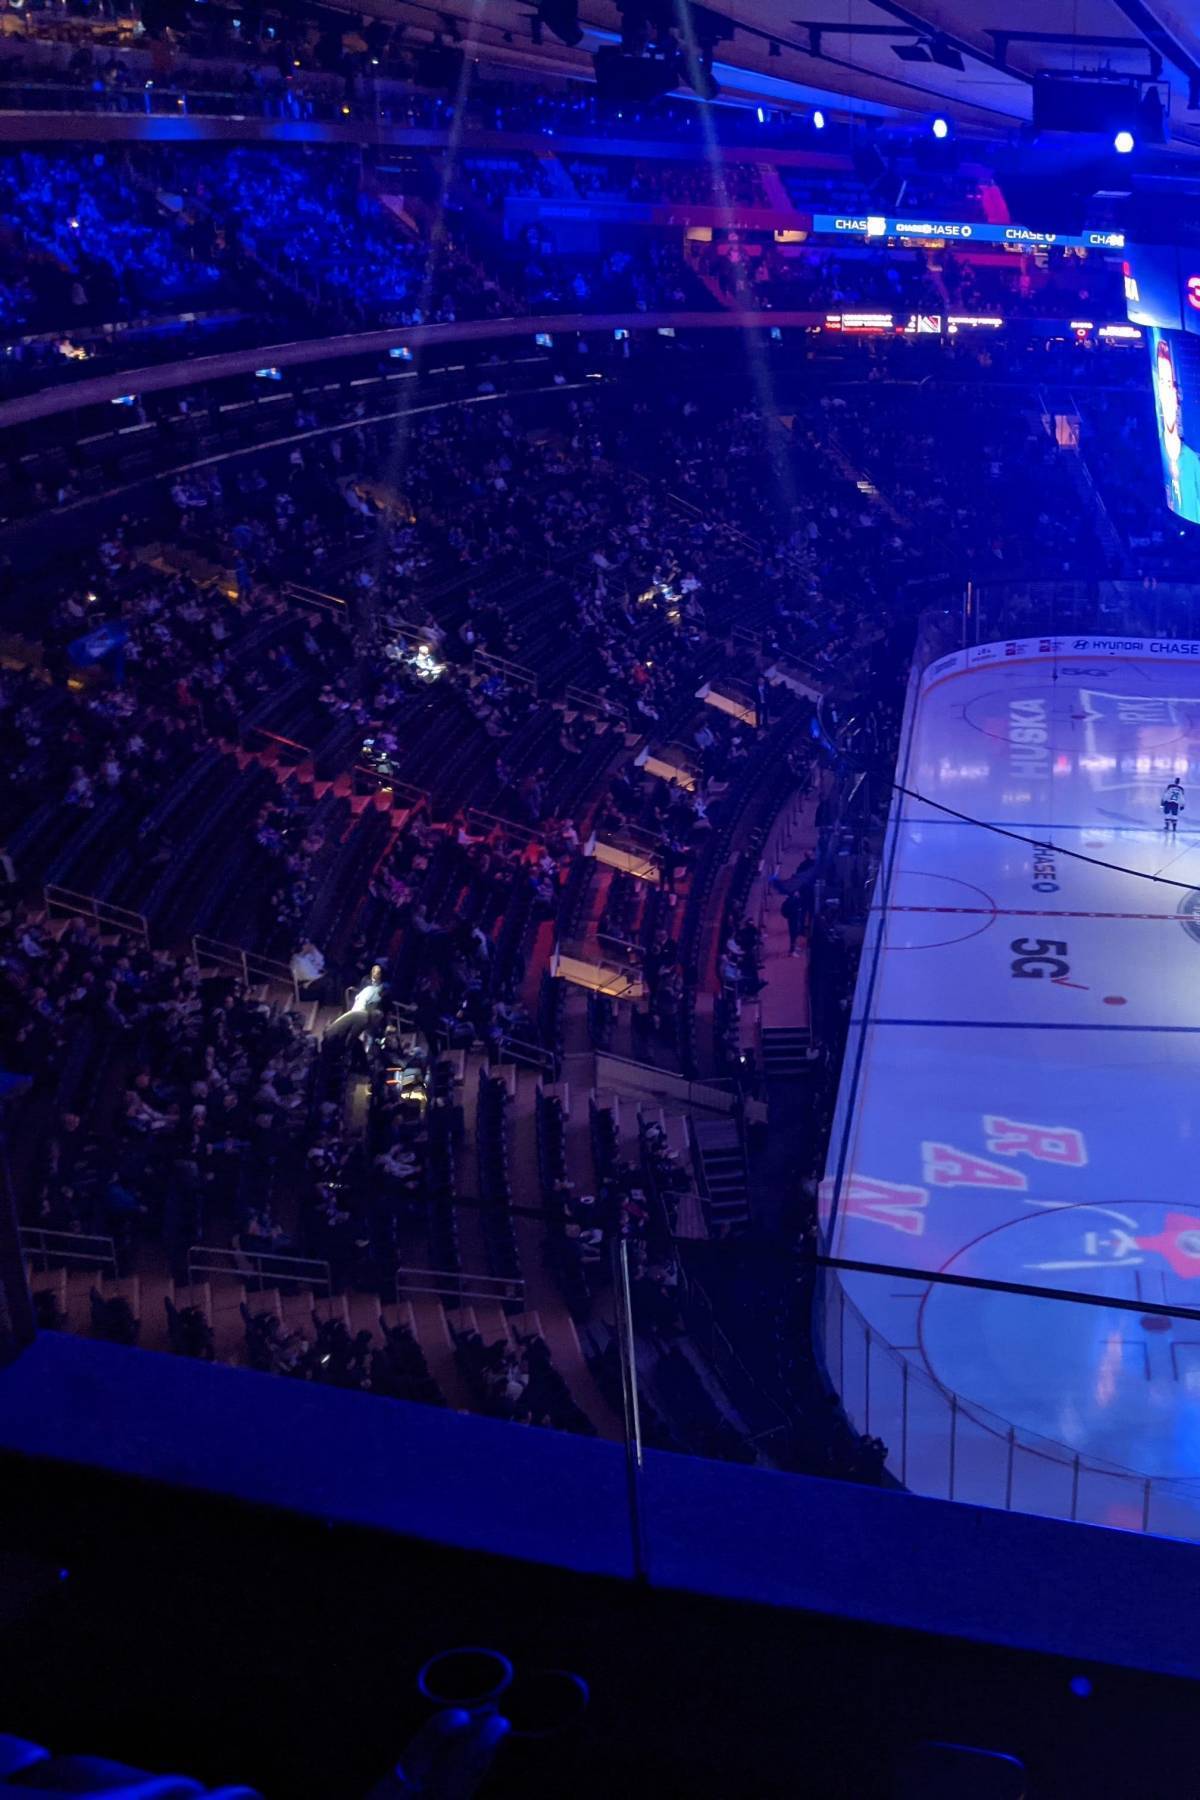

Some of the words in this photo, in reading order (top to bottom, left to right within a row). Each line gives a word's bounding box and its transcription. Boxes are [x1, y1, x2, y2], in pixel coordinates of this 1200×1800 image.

[835, 219, 869, 231] CHAS
[1092, 641, 1144, 651] HYUNDAI
[1150, 642, 1200, 655] CHASE
[1009, 699, 1049, 780] HUSKA
[1010, 937, 1070, 979] 5G
